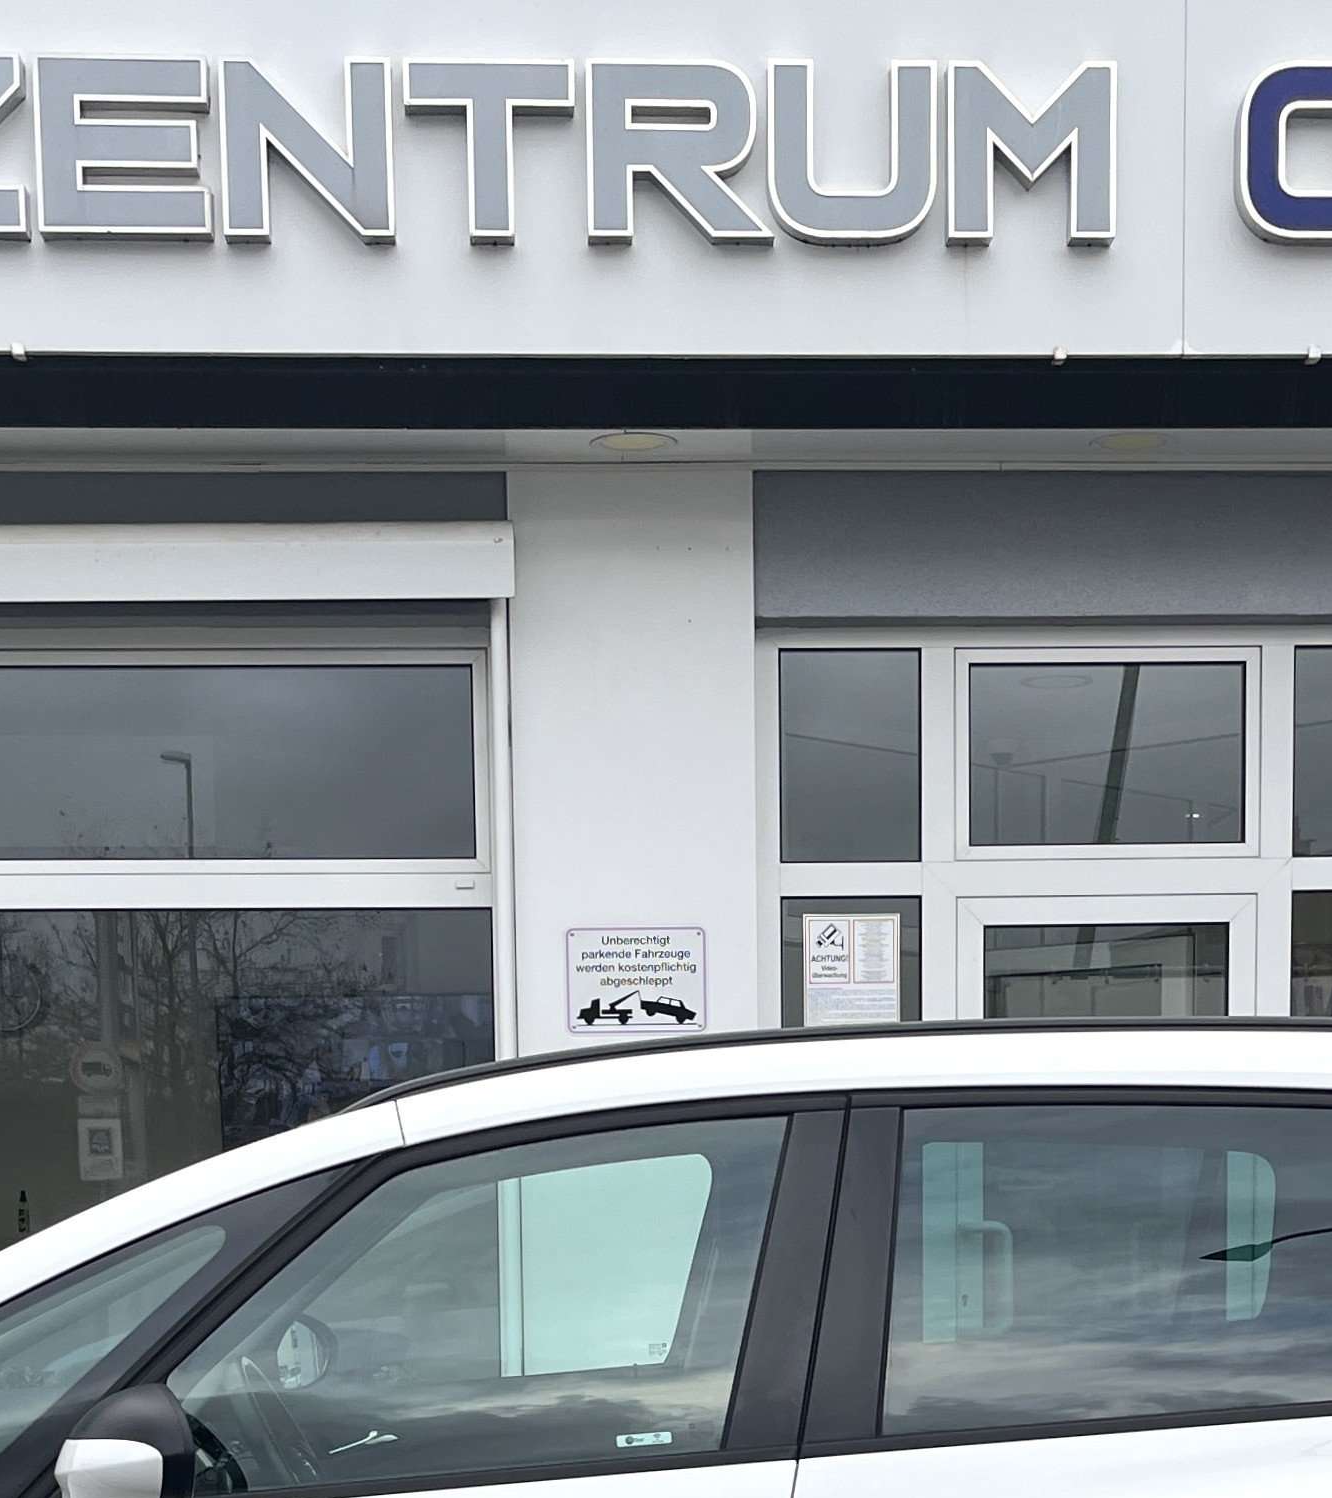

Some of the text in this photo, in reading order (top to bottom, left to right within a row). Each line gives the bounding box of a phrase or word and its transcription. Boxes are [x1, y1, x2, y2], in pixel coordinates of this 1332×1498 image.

[601, 935, 671, 947] Unberechtigt
[581, 948, 691, 961] parkende Fahrzeuge
[575, 962, 697, 974] werden kostenpflichtig
[600, 976, 673, 988] abgeschleppt
